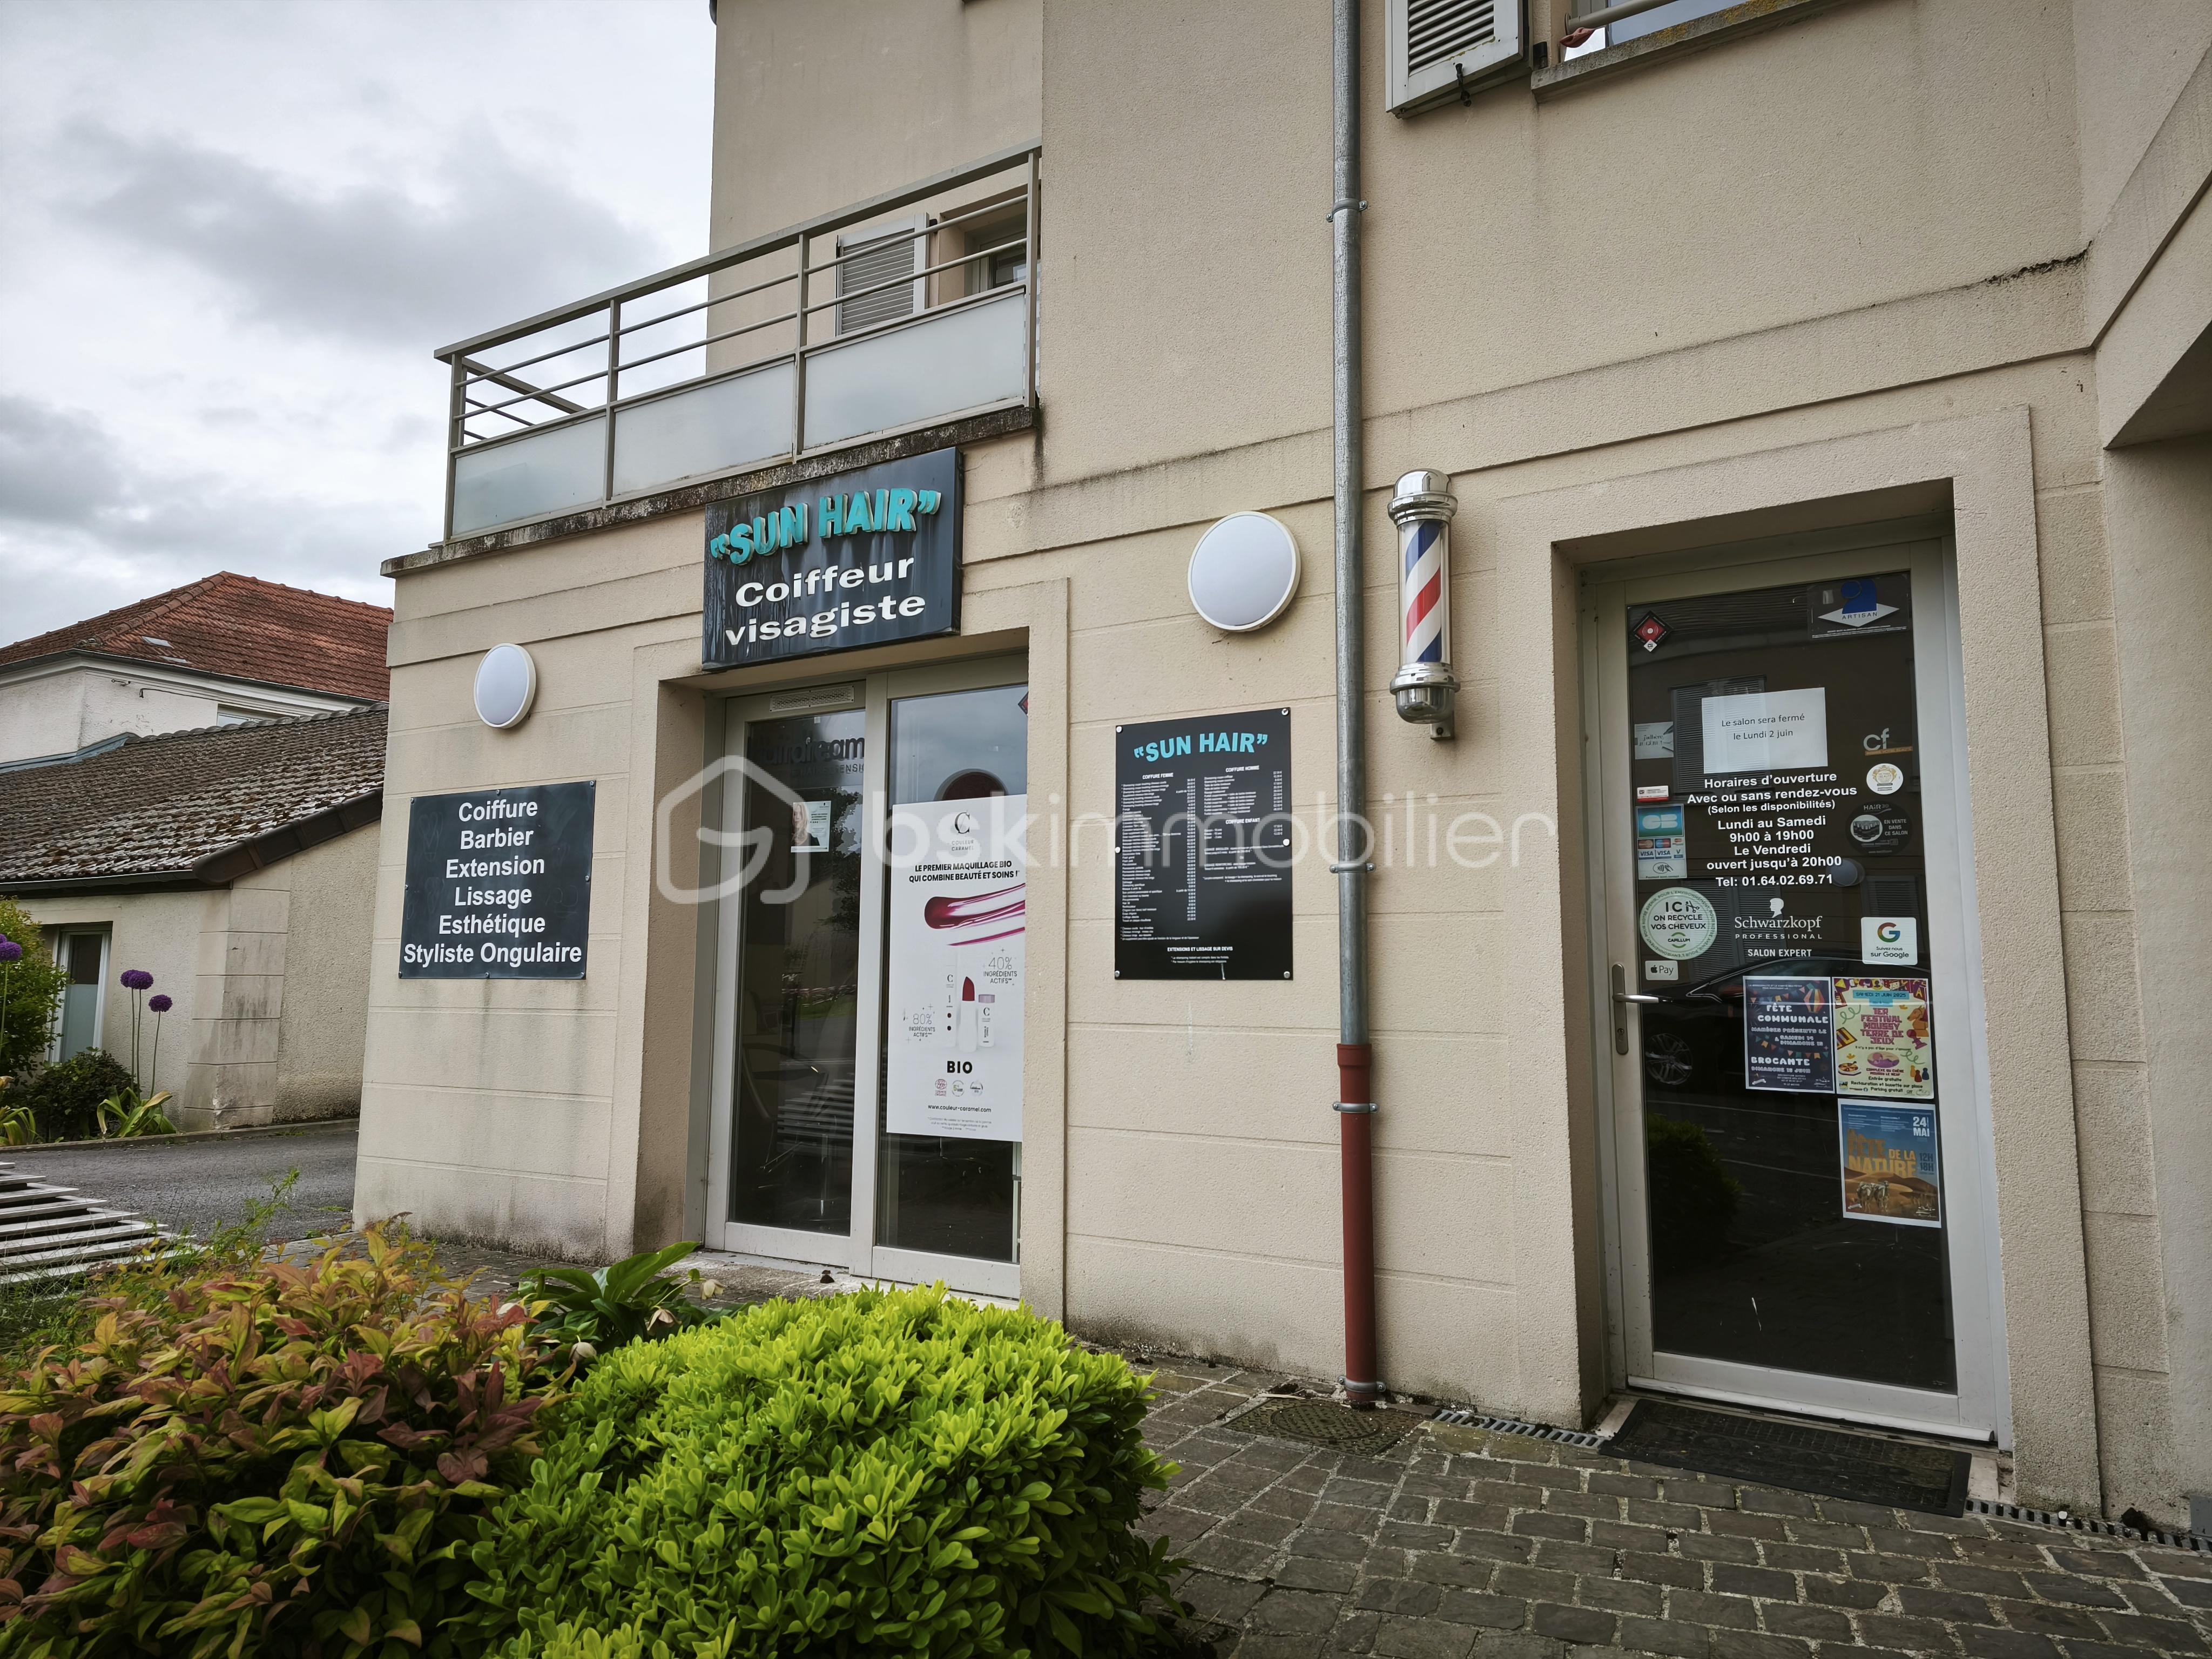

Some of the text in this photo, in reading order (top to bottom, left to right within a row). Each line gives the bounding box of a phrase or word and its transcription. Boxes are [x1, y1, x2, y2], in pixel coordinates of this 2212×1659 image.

[736, 557, 914, 608] Coiffeur
[725, 595, 926, 646] visagiste
[1842, 612, 1877, 620] ARTISAN
[1733, 718, 1755, 726] salon
[1778, 713, 1805, 723] fermé
[1743, 730, 1766, 739] Lundi
[1776, 729, 1793, 739] juin
[1704, 777, 1757, 788] Horaires
[1687, 787, 1857, 804] Avec ou sans rendez-vous
[458, 799, 538, 822] Coiffure
[1708, 800, 1836, 815] (Selon les disponibilités)
[1642, 813, 1678, 830] CB
[1718, 815, 1826, 830] Lundi au Samedi
[460, 827, 534, 849] Barbier
[1730, 830, 1814, 842] 9h00 à 19h00
[1734, 843, 1811, 856] Le Vendredi
[446, 855, 544, 879] Extension
[953, 861, 998, 871] MAQUILLAGE
[1707, 860, 1747, 870] ouvert
[1802, 855, 1842, 867] 20h00
[909, 874, 921, 882] QUI
[922, 873, 954, 882] COMBINE
[955, 871, 982, 881] BEAUTÉ
[992, 871, 1014, 879] SOINS
[1715, 874, 1833, 887] Tel: 01.64.02.69.71
[455, 886, 532, 909] Lissage
[439, 913, 545, 938] Esthétique
[1735, 916, 1822, 932] Schwarzkopf
[403, 942, 582, 968] Styliste Ongulaire
[1778, 949, 1812, 957] EXPERT
[988, 957, 1013, 970] 40%
[1659, 965, 1674, 976] Pay
[1766, 1003, 1792, 1012] FÊTE
[913, 1013, 932, 1025] 80%
[1757, 1015, 1829, 1023] COMMUNALE
[1860, 1015, 1903, 1023] FESTIVAL
[1870, 1036, 1894, 1044] JEUX
[1751, 1056, 1810, 1065] BROCANTE
[947, 1061, 973, 1074] BIO
[928, 1104, 992, 1112] www.couleur-caramel.com
[1913, 1116, 1927, 1127] 24
[1913, 1127, 1930, 1137] MAI
[1889, 1149, 1917, 1161] DE LA
[1919, 1152, 1933, 1162] 12H
[1848, 1155, 1917, 1178] NATURE
[1920, 1162, 1934, 1172] 18H
